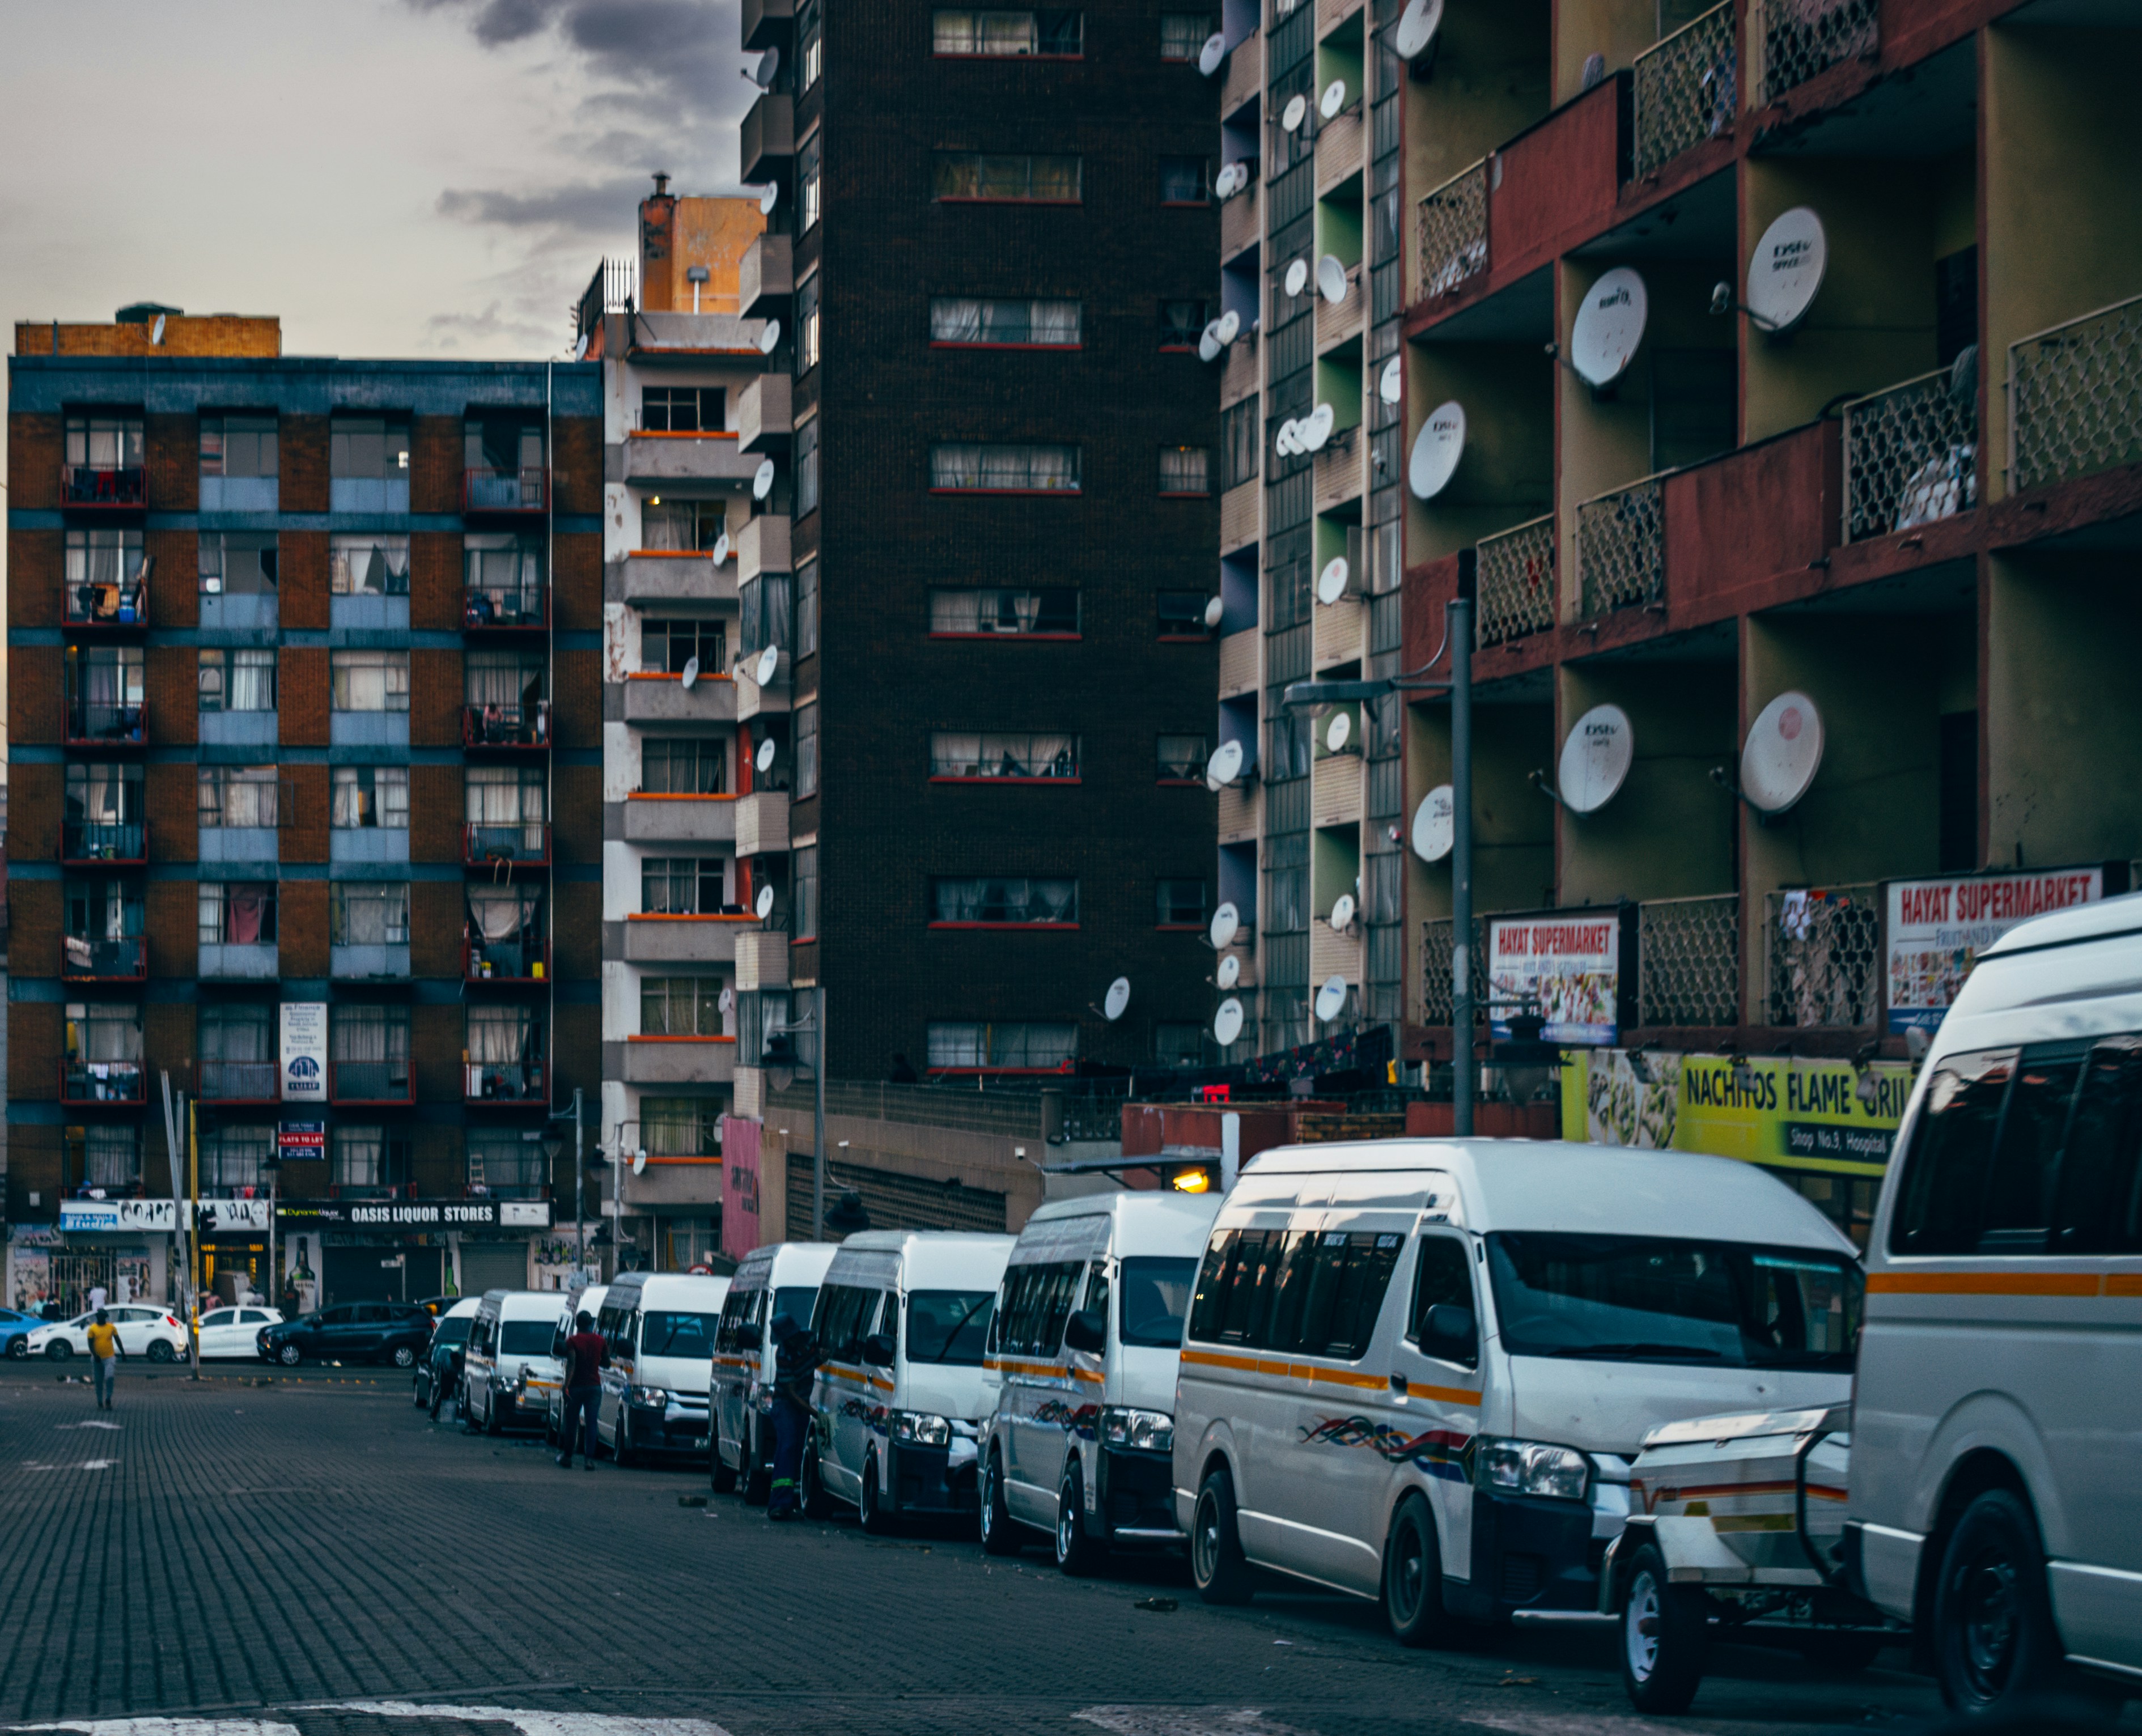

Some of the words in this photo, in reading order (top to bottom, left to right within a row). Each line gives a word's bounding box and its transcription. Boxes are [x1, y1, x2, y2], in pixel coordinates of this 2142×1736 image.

[1901, 886, 1952, 925] HAYAT
[1956, 875, 2092, 921] SUPERMARKET
[1499, 927, 1529, 956] HAYAT
[1532, 924, 1611, 956] SUPERMARKET
[1787, 1073, 1851, 1114] FLAME
[1864, 1078, 1915, 1117] RIL
[351, 1207, 390, 1223] OASIS
[393, 1206, 438, 1224] LIQUOR
[444, 1206, 493, 1222] STORES
